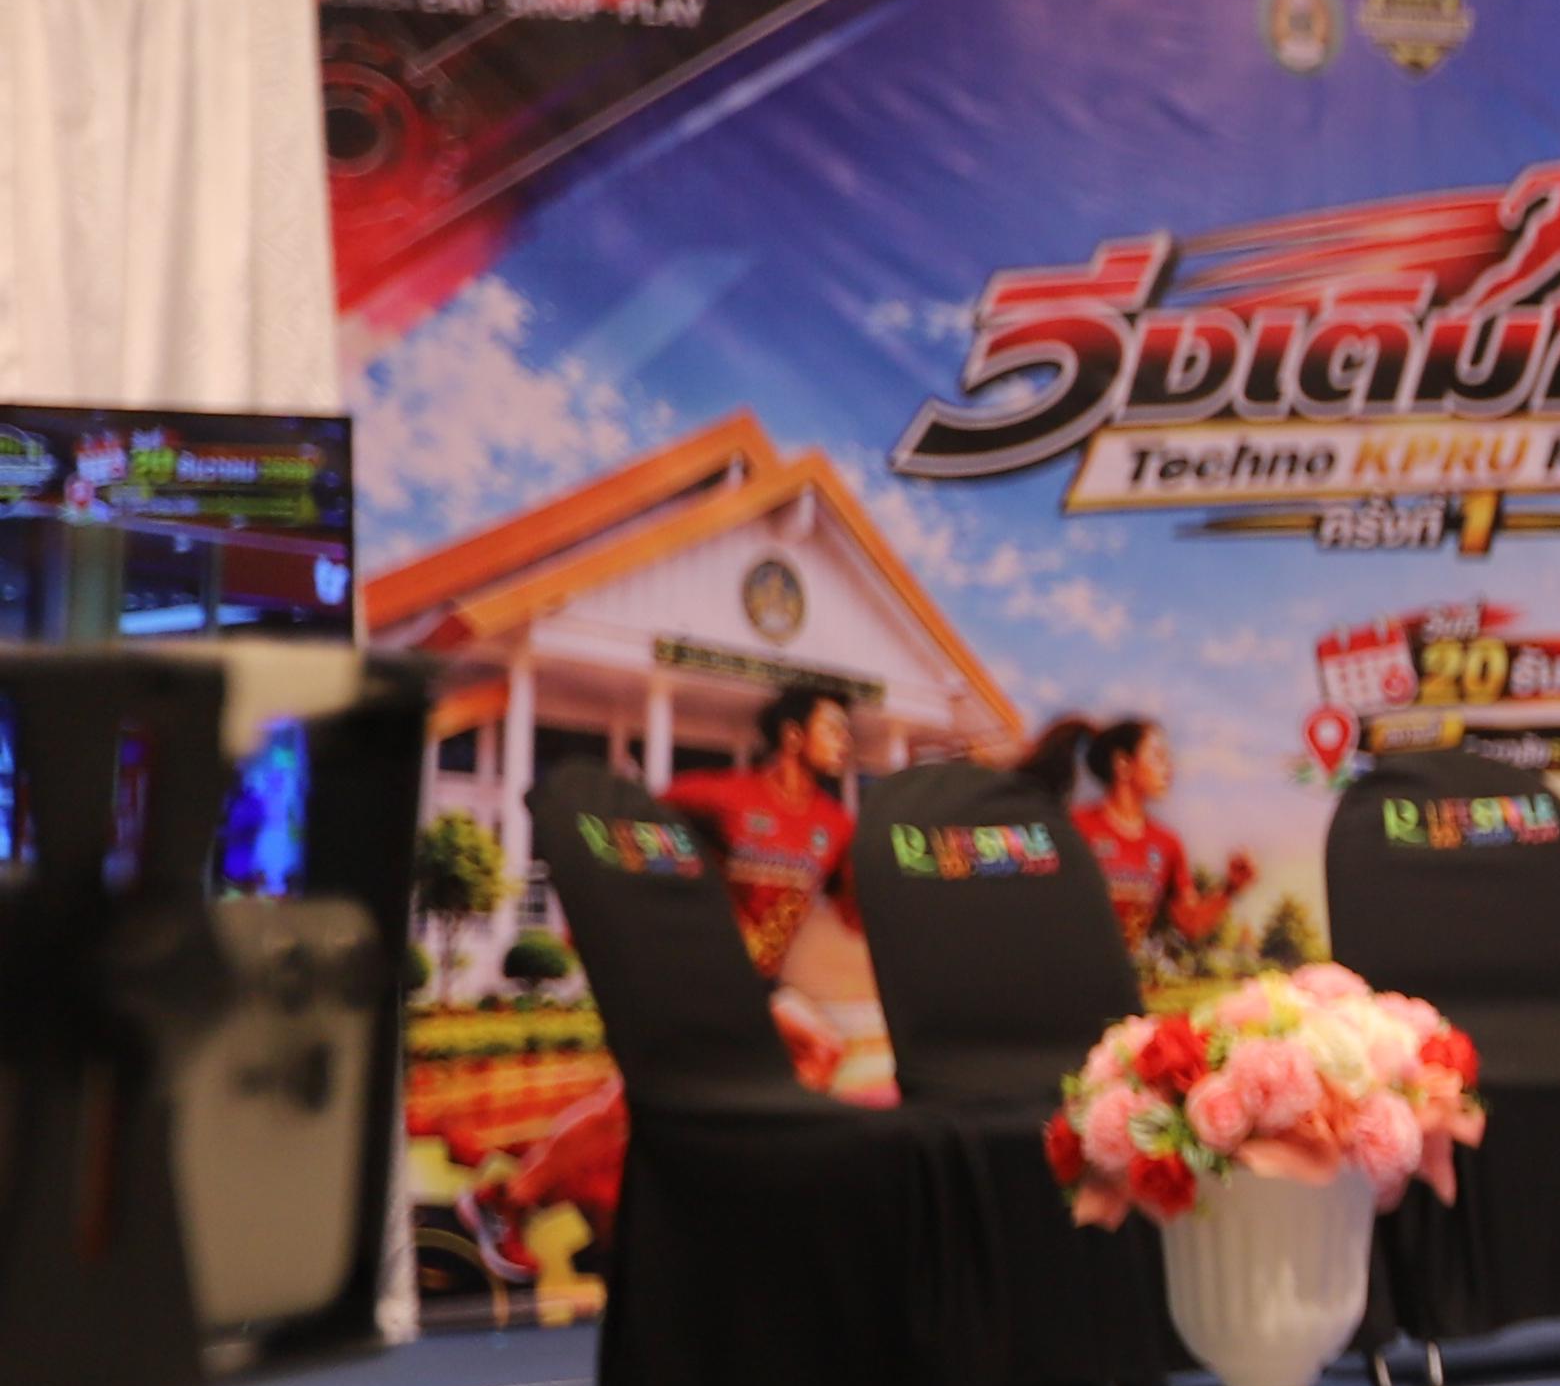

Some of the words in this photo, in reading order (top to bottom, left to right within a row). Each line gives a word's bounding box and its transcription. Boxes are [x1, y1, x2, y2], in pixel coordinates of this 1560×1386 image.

[1130, 439, 1336, 485] Techno
[1353, 435, 1529, 475] KPRU
[1420, 637, 1508, 705] 20
